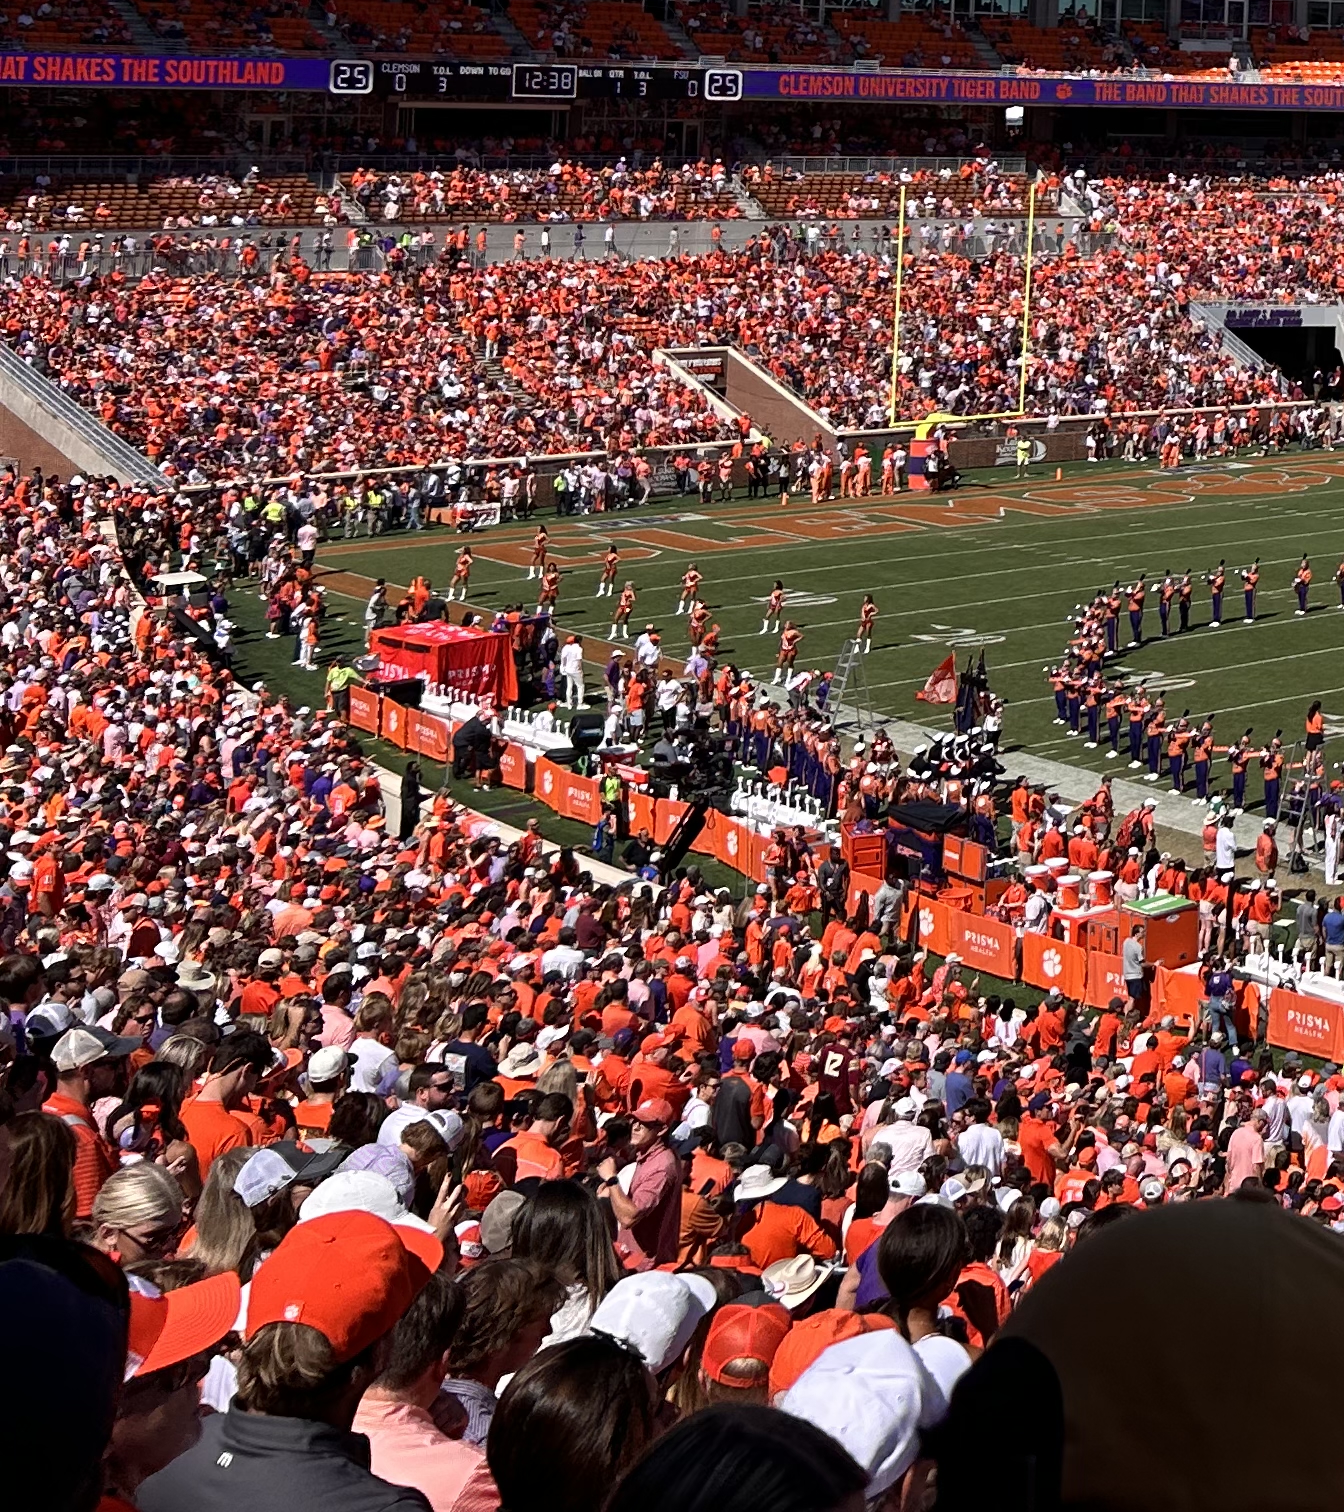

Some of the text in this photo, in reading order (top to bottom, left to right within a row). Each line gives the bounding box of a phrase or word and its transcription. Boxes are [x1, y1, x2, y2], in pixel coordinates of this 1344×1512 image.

[33, 57, 114, 82] SHAKES
[120, 58, 160, 83] THE
[164, 60, 285, 85] SOUTHLAND
[337, 66, 367, 88] 25
[381, 63, 421, 74] CLEMSON
[460, 66, 484, 75] DOWN
[488, 66, 499, 75] TO
[674, 71, 689, 79] FSU
[395, 74, 407, 91] 0
[438, 77, 447, 92] 3
[524, 71, 572, 89] 12:38
[639, 82, 647, 95] 3
[688, 80, 698, 97] 0
[711, 75, 736, 95] 25
[779, 74, 1041, 100] CLEMSON UNIVERSITY TIGER BAND
[1093, 82, 1121, 101] THE
[1125, 84, 1167, 103] BAND
[1170, 85, 1206, 104] THAT
[1209, 86, 1268, 106] SHAKES
[1273, 88, 1300, 106] THE
[964, 930, 1000, 951] PRISMA
[1287, 1009, 1330, 1032] PRISMA
[824, 1050, 845, 1077] 12
